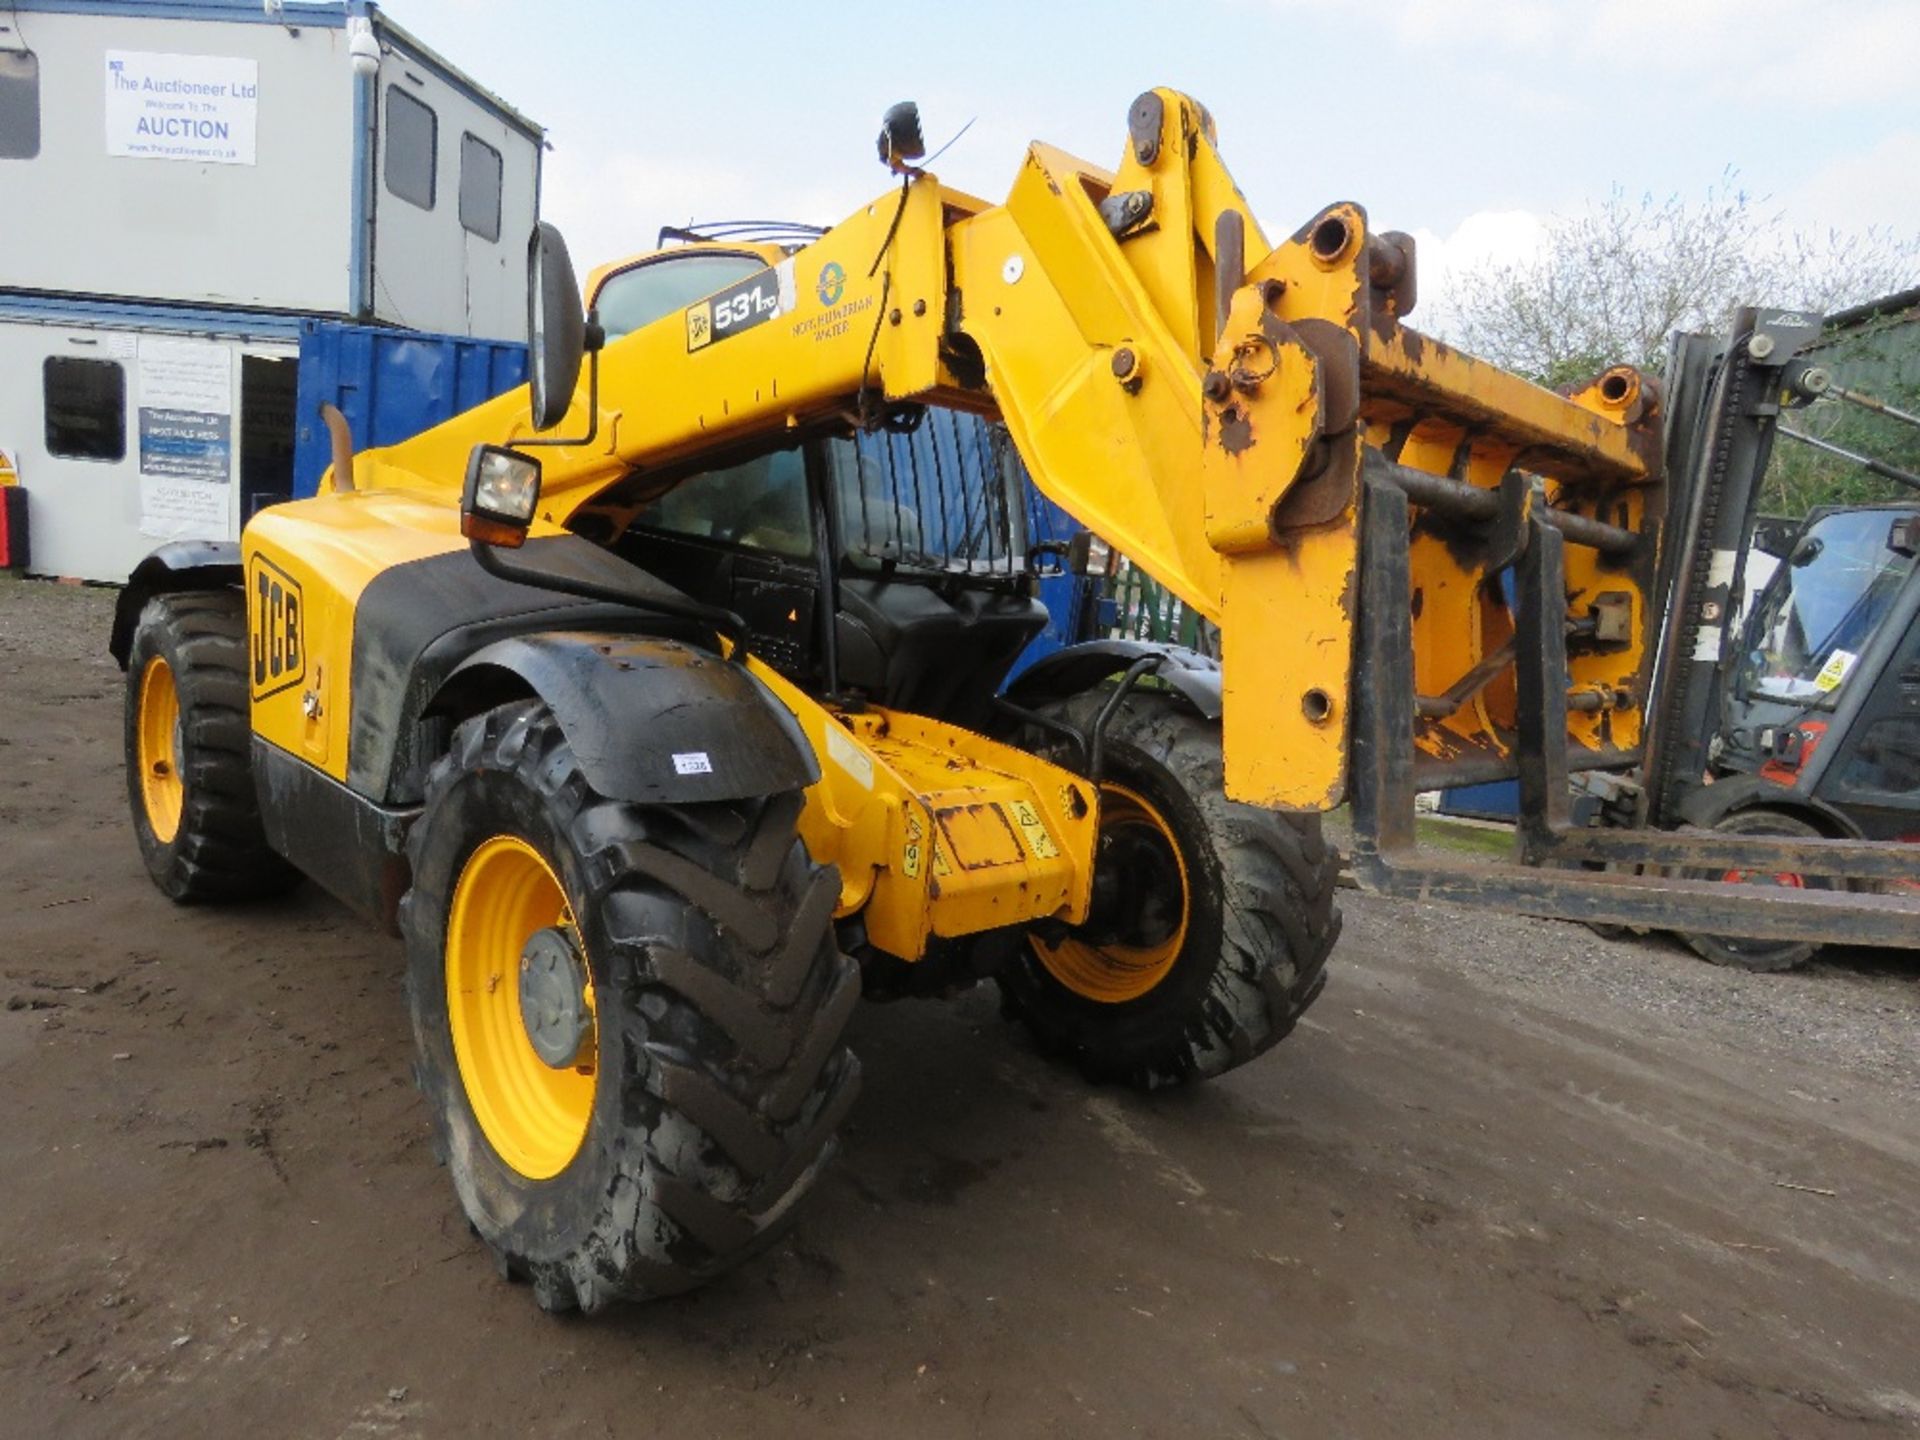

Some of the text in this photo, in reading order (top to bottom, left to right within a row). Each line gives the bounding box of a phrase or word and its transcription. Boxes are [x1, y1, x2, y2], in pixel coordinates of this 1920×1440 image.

[114, 71, 257, 99] The Auctioneer Ltd
[136, 117, 229, 140] AUCTION
[714, 286, 762, 329] 531
[816, 320, 850, 341] WATER
[253, 571, 299, 686] JCB
